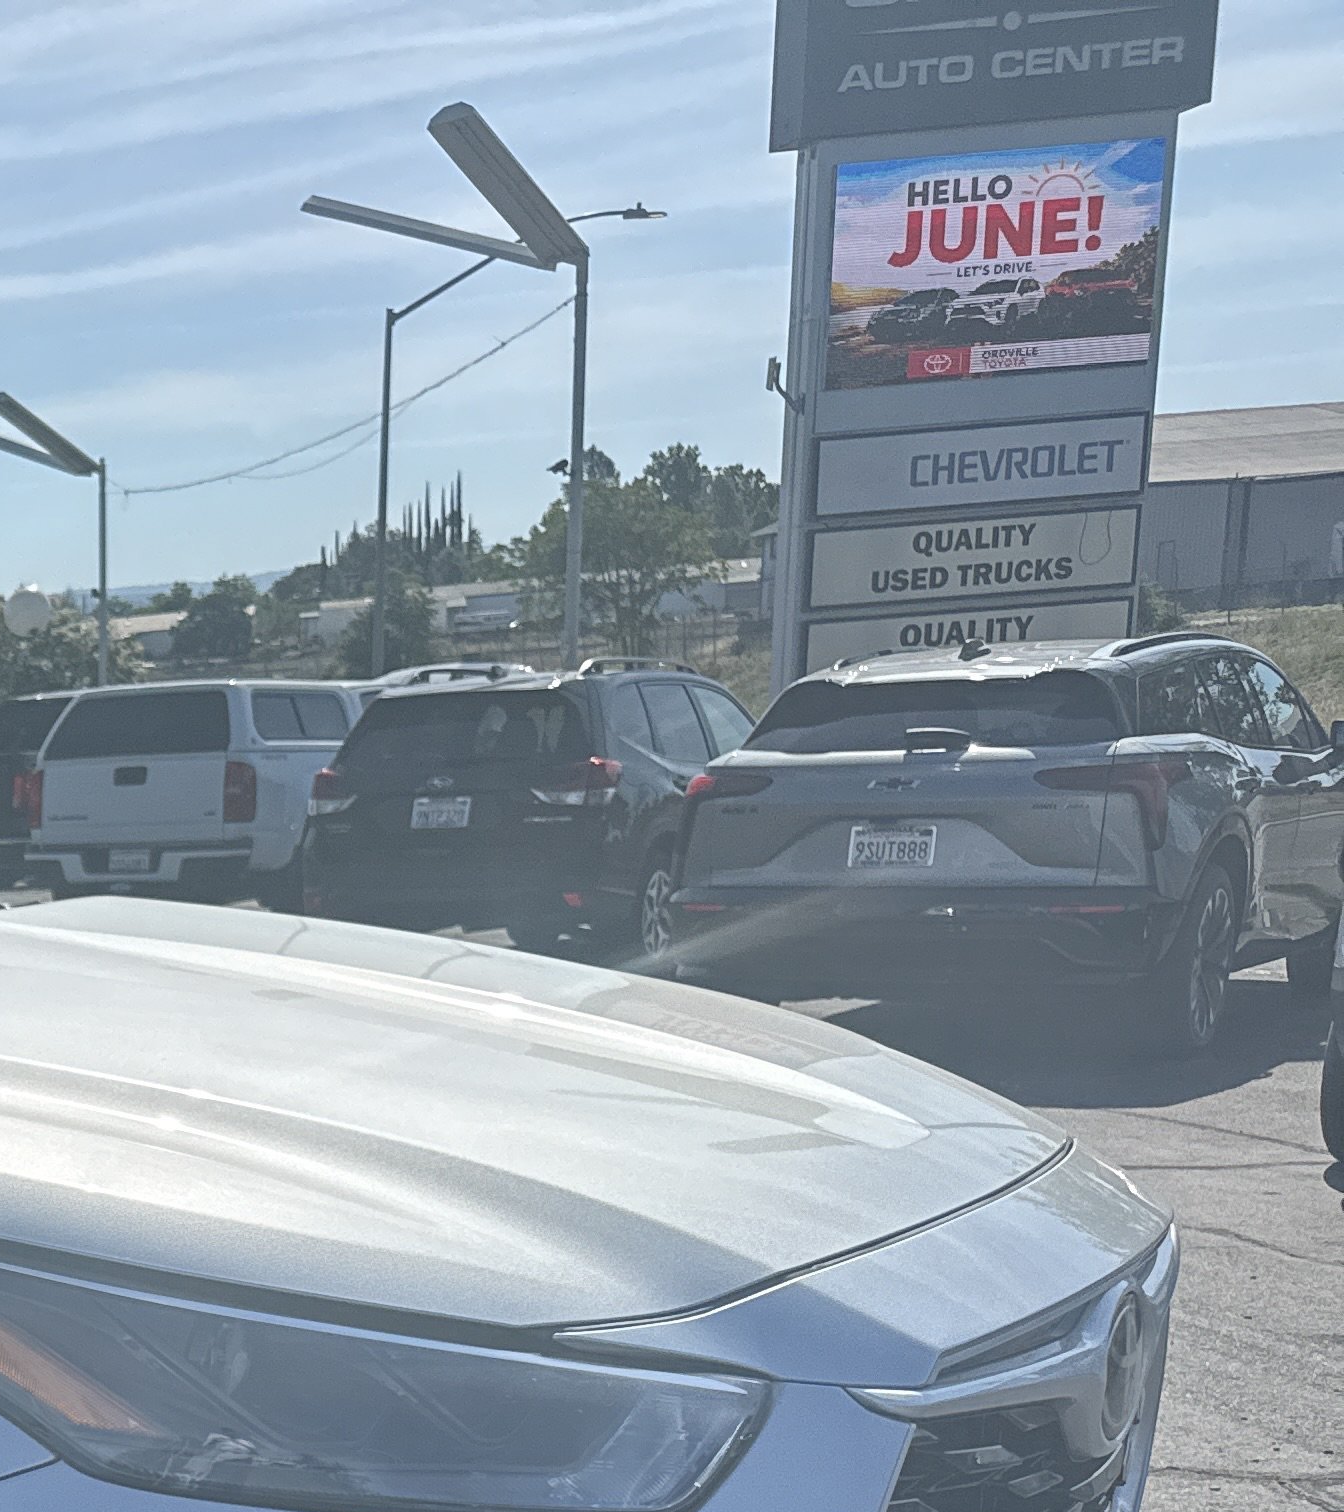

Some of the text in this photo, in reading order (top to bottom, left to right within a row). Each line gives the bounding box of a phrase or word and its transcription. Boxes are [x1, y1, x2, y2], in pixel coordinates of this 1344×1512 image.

[837, 36, 1185, 93] AUTO CENTER
[907, 174, 1013, 207] HELLO
[887, 195, 1105, 268] JUNE!
[956, 264, 990, 278] LET'S
[981, 357, 1028, 369] TOYOTA
[910, 439, 1124, 487] CHEVROLET
[912, 523, 1036, 557] QUALITY
[871, 557, 1073, 593] USED TRUCKS
[900, 615, 1034, 647] QUALITY
[854, 841, 929, 861] 9SUT888
